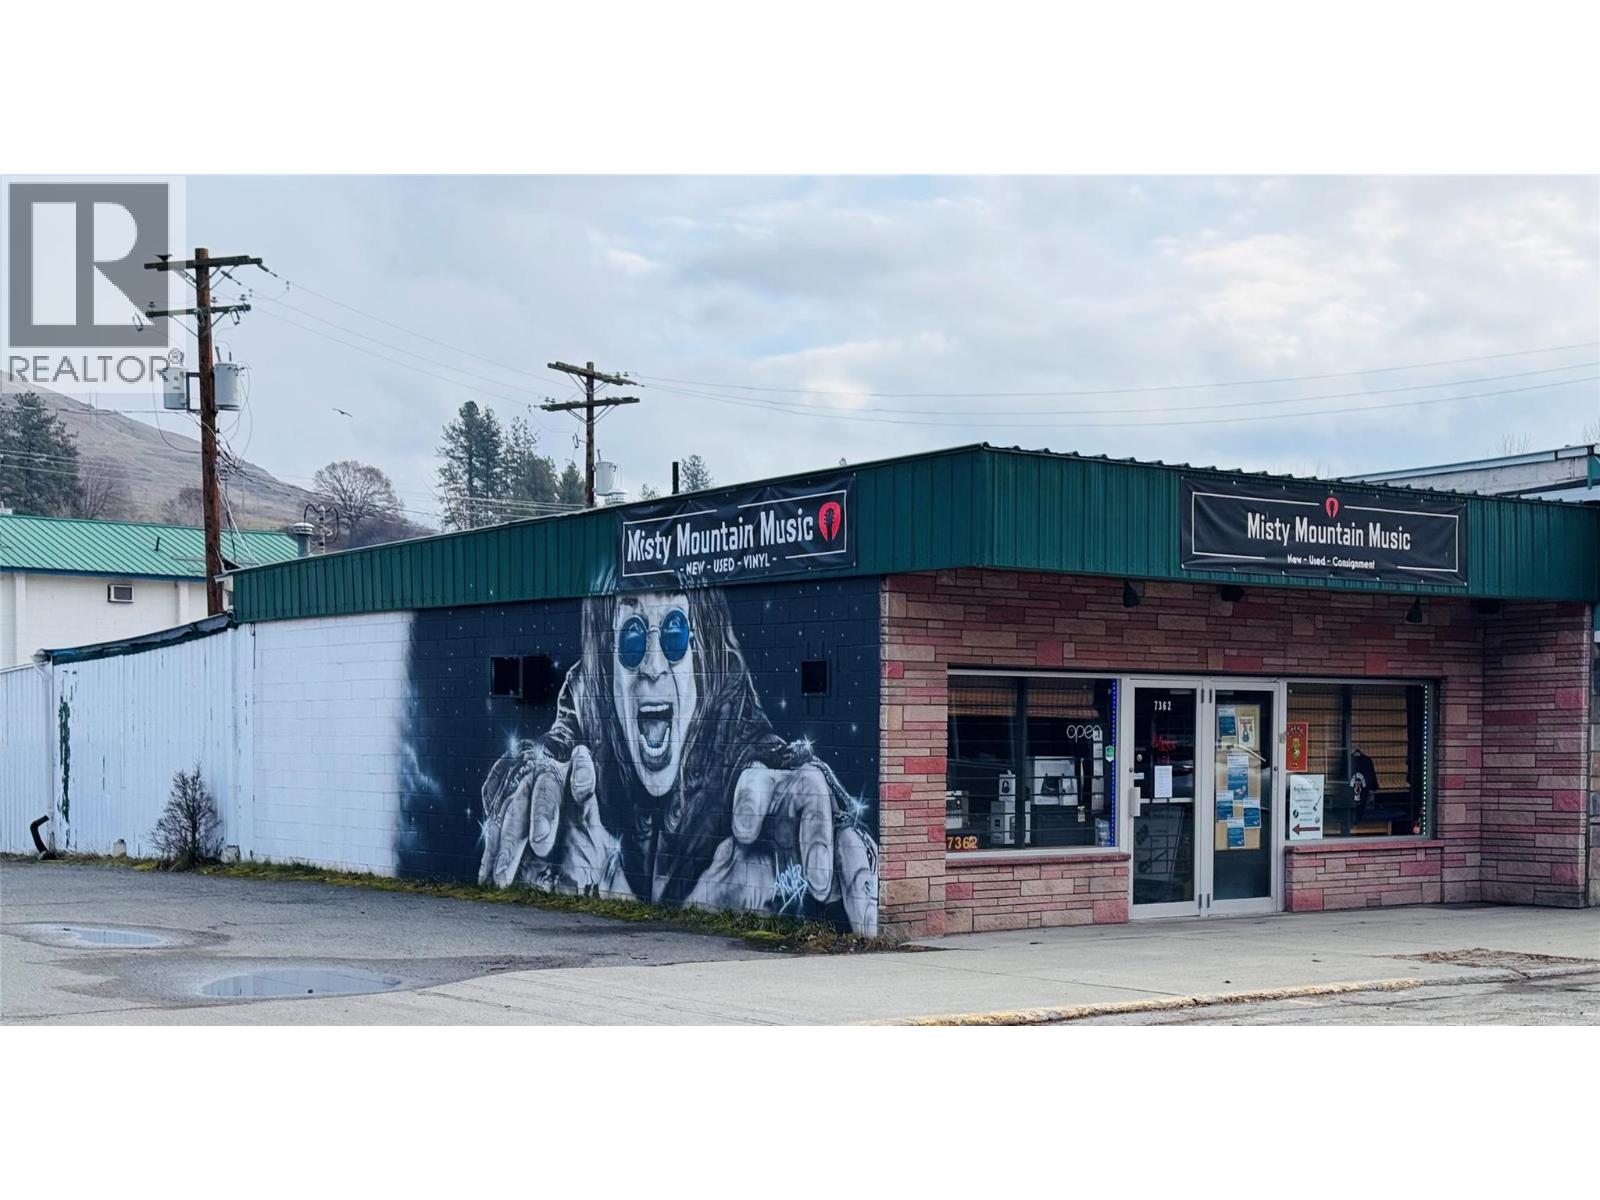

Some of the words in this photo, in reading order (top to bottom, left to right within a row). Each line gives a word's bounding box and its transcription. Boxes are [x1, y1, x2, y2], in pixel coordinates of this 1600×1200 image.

[627, 528, 672, 565] Misty
[676, 516, 754, 557] Mountain
[760, 508, 814, 547] Music
[1247, 511, 1291, 546] Misty
[1295, 515, 1364, 547] Mountain
[1368, 522, 1411, 551] Music
[686, 560, 706, 576] NEW
[713, 557, 735, 573] USED
[743, 553, 771, 569] VINYL
[1287, 553, 1302, 565] New
[1308, 555, 1326, 566] Used
[1332, 556, 1376, 570] Consignment
[1154, 700, 1172, 711] 7362
[946, 836, 978, 850] 7362
